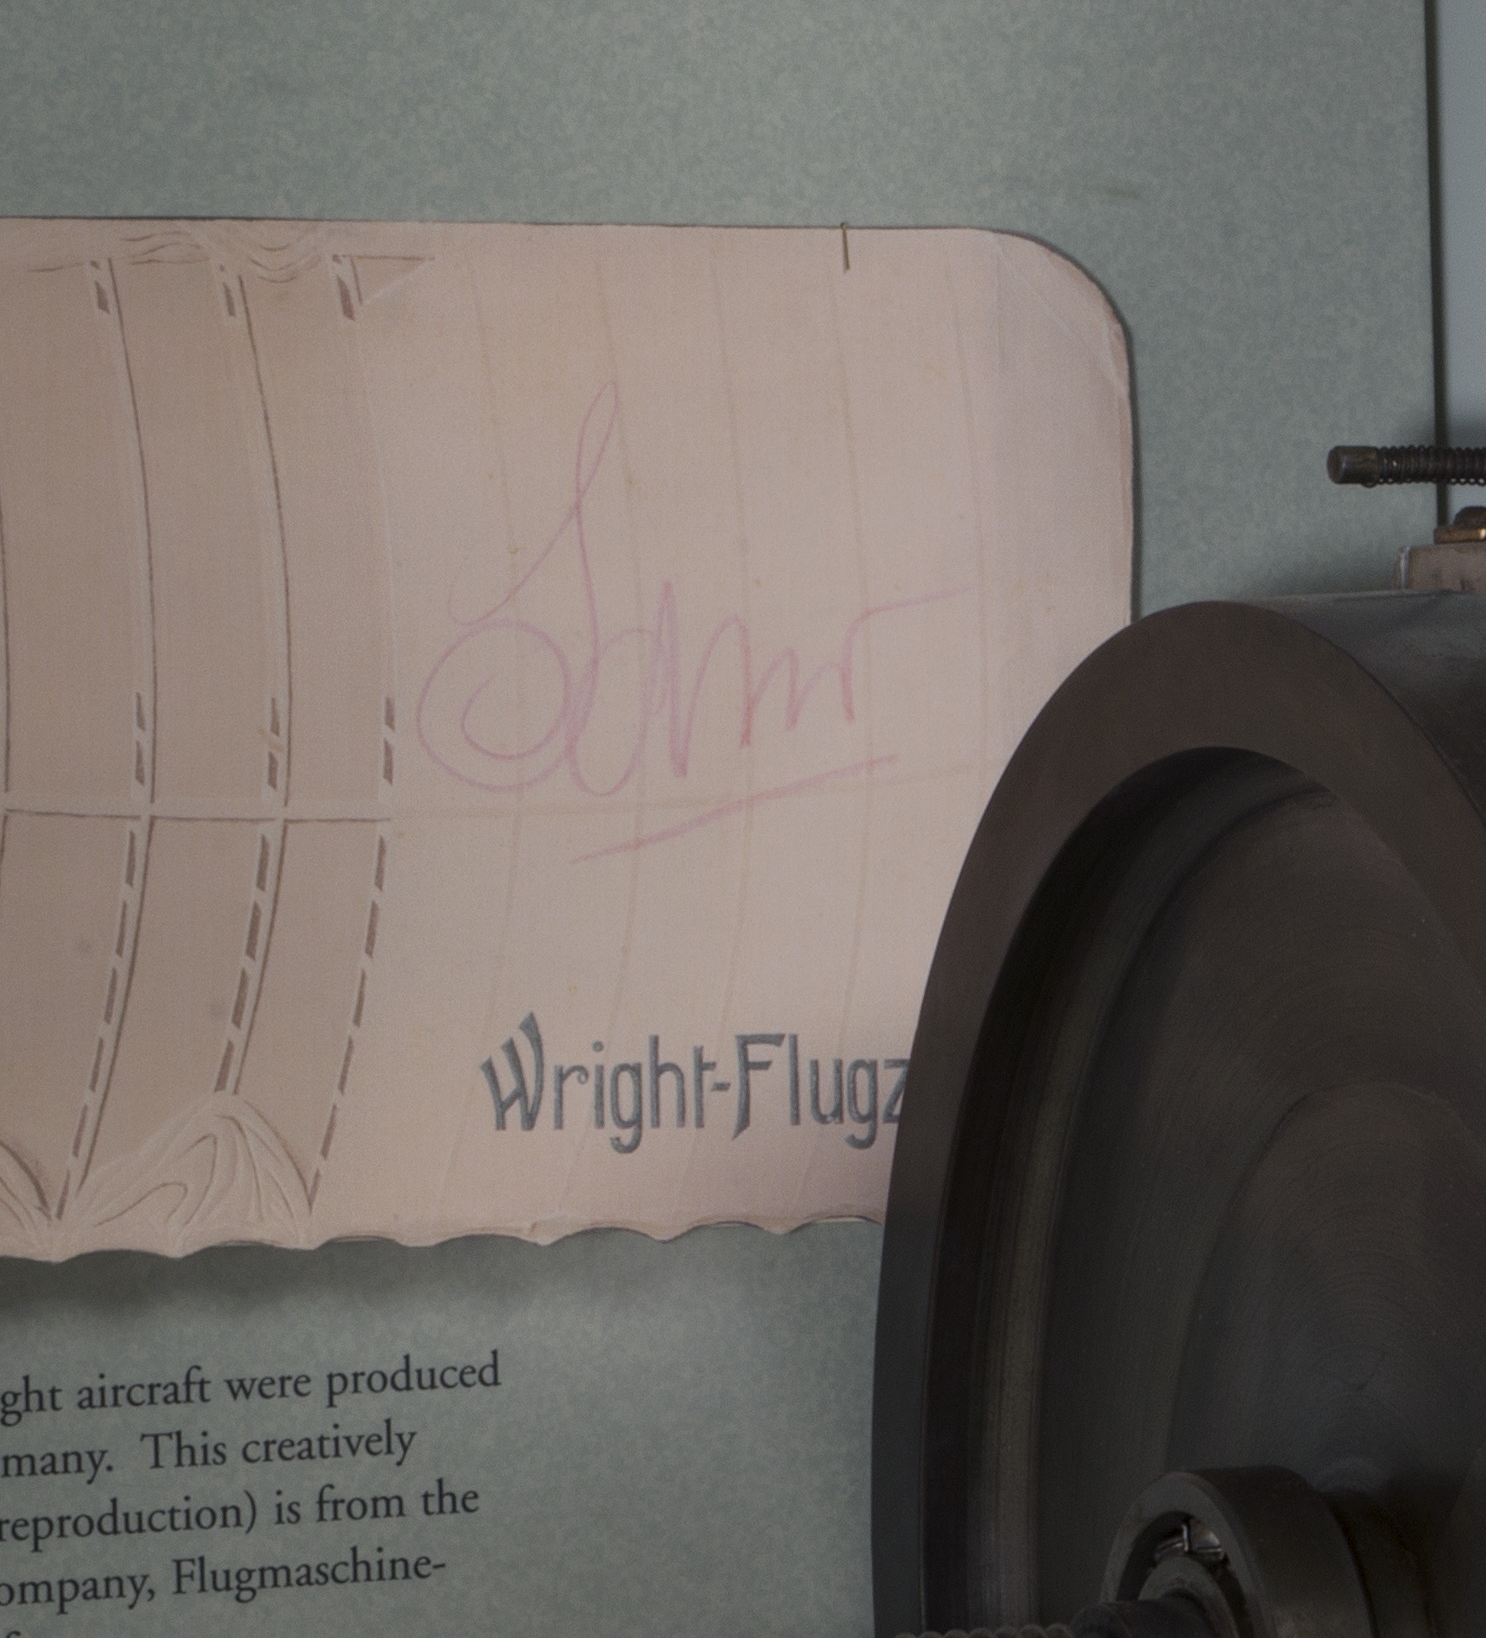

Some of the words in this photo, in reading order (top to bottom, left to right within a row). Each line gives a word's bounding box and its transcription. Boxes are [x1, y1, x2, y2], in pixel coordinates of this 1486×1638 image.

[77, 1365, 211, 1410] aircraft
[224, 1375, 311, 1401] were
[326, 1349, 501, 1408] produced
[140, 1430, 226, 1469] This
[242, 1418, 417, 1467] creatively
[275, 1490, 301, 1524] is
[316, 1484, 406, 1522] from
[422, 1478, 479, 1516] the
[172, 1546, 446, 1603] Flugmaschine-
